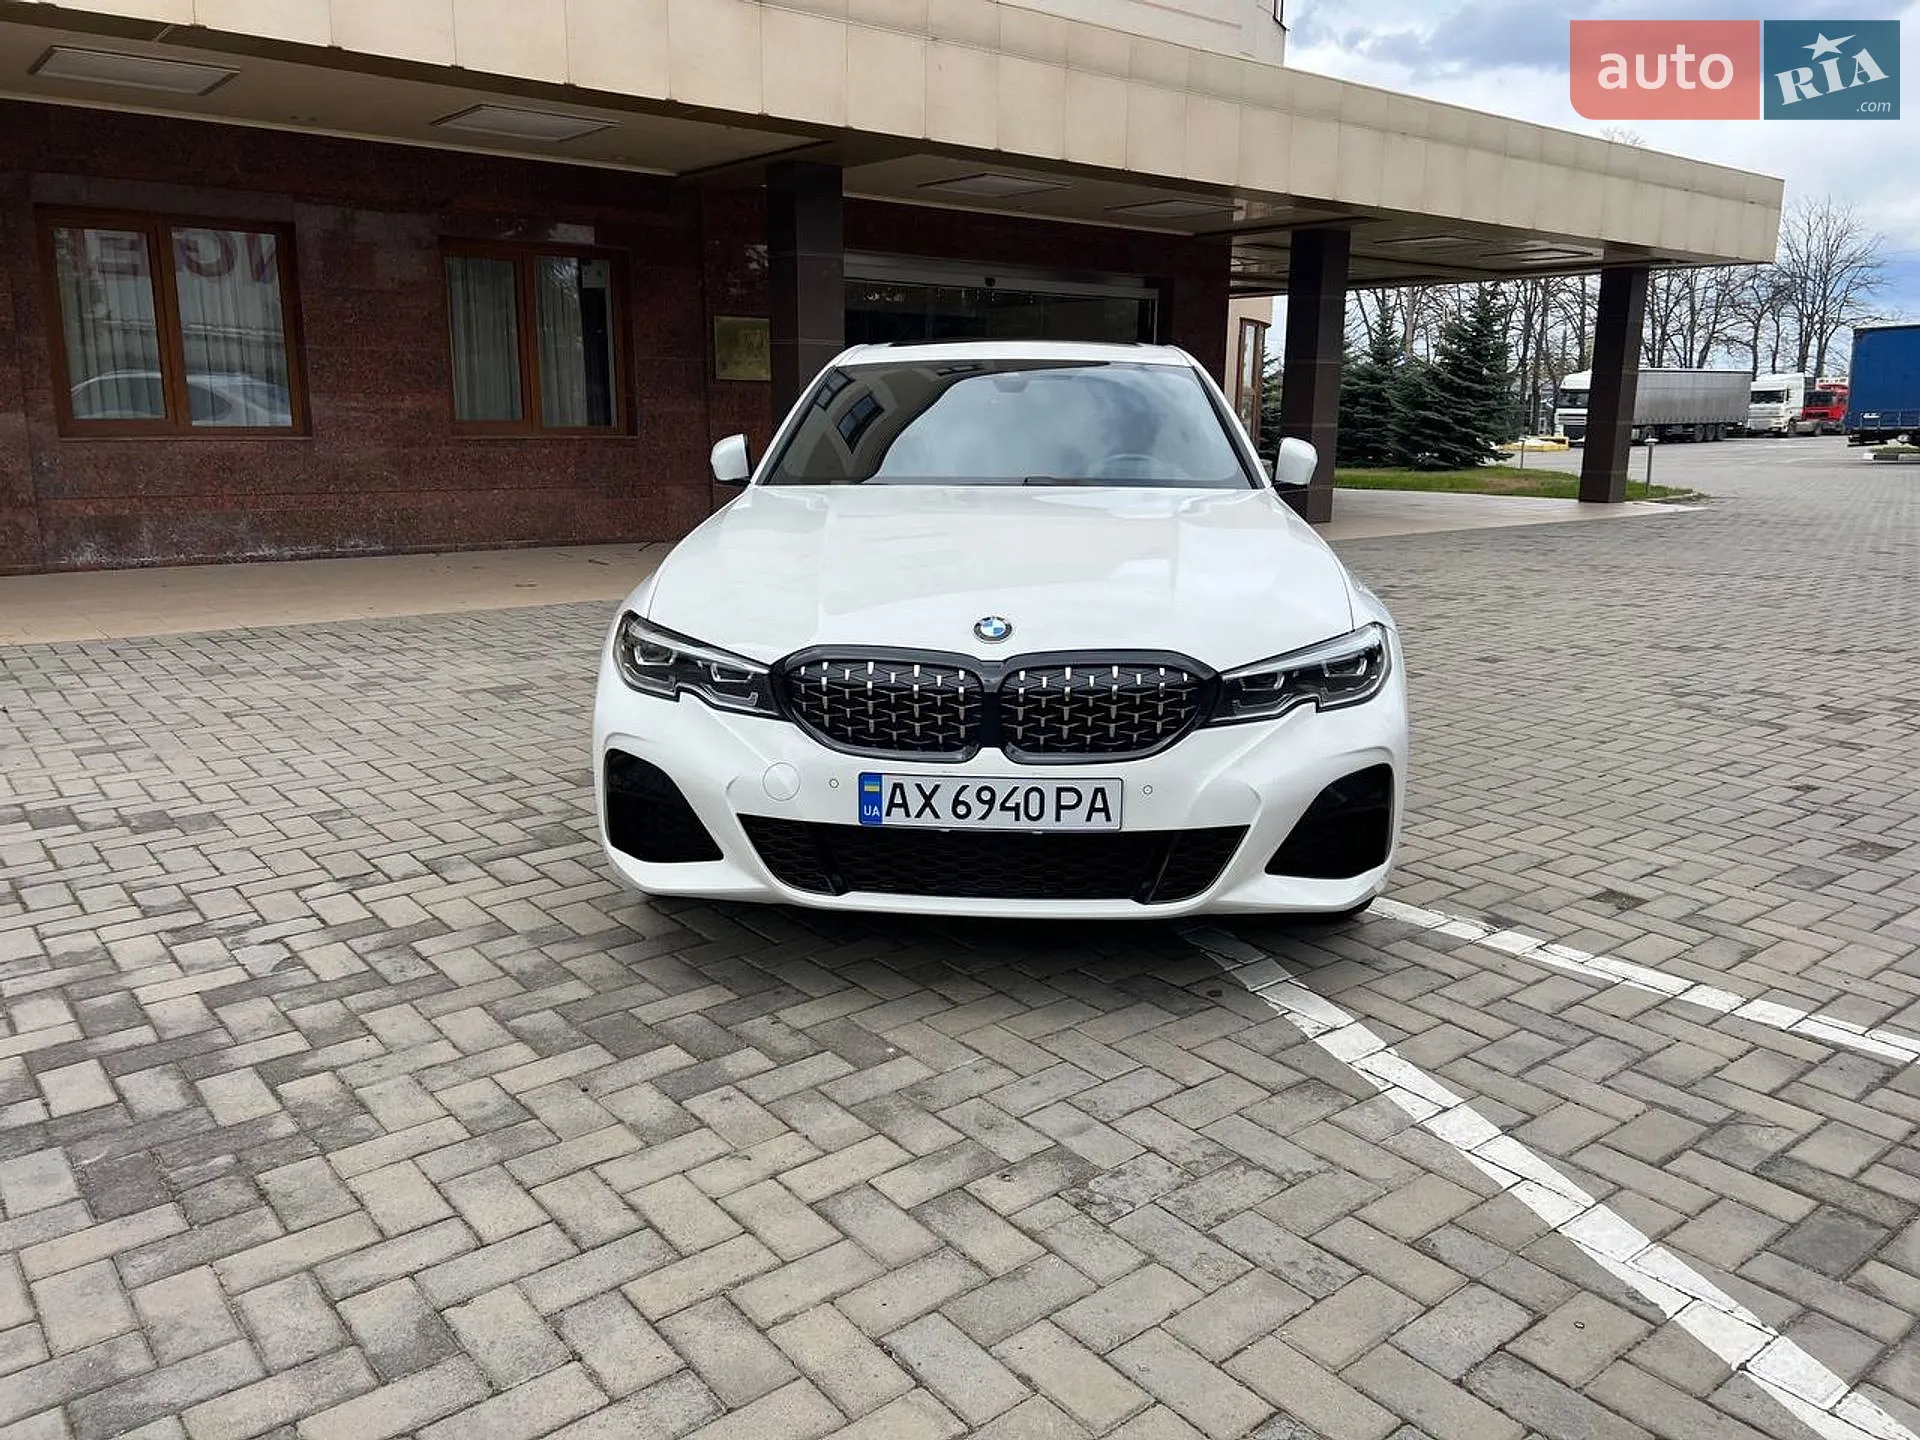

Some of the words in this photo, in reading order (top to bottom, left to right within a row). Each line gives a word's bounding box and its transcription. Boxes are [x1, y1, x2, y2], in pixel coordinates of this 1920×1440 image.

[863, 805, 880, 817] UA
[885, 782, 941, 819] AX
[951, 784, 1046, 822] 6940
[1054, 786, 1112, 823] PA
